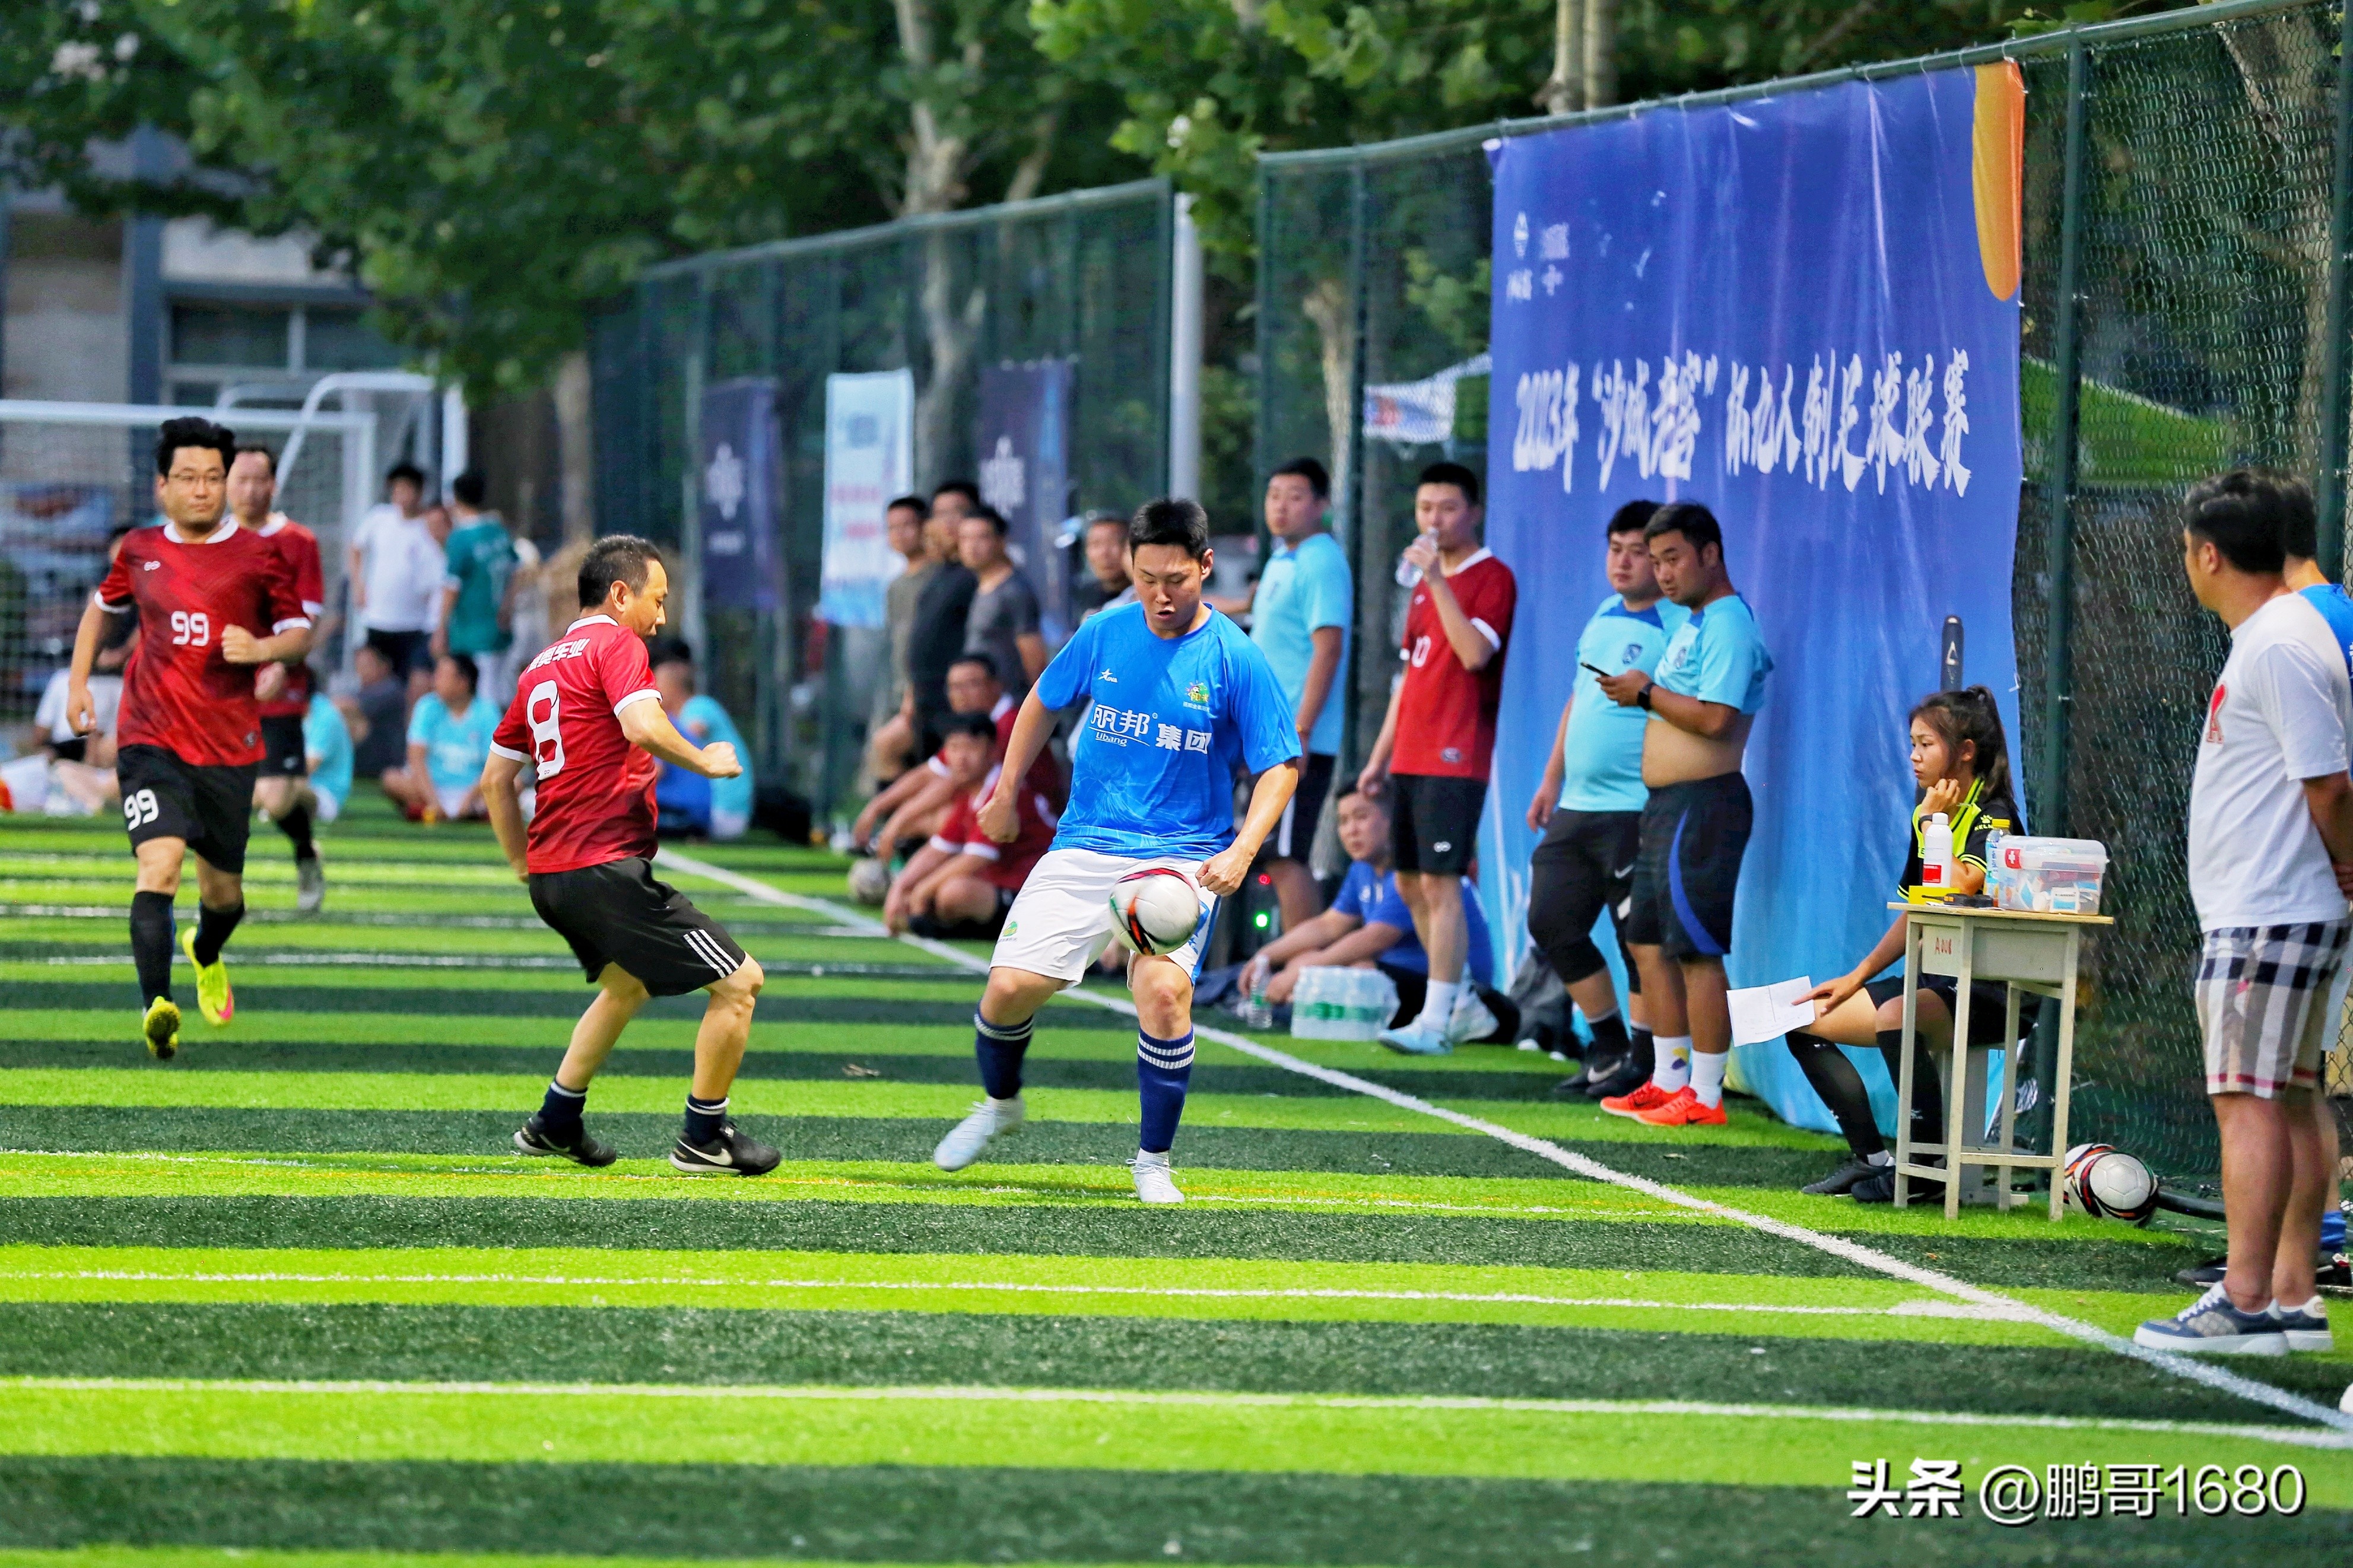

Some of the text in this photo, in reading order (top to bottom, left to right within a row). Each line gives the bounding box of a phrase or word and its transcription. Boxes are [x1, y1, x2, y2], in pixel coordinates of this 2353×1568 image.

[171, 611, 209, 647] 99
[527, 679, 566, 781] 8
[1155, 723, 1212, 754] 集团
[123, 788, 159, 832] 99
